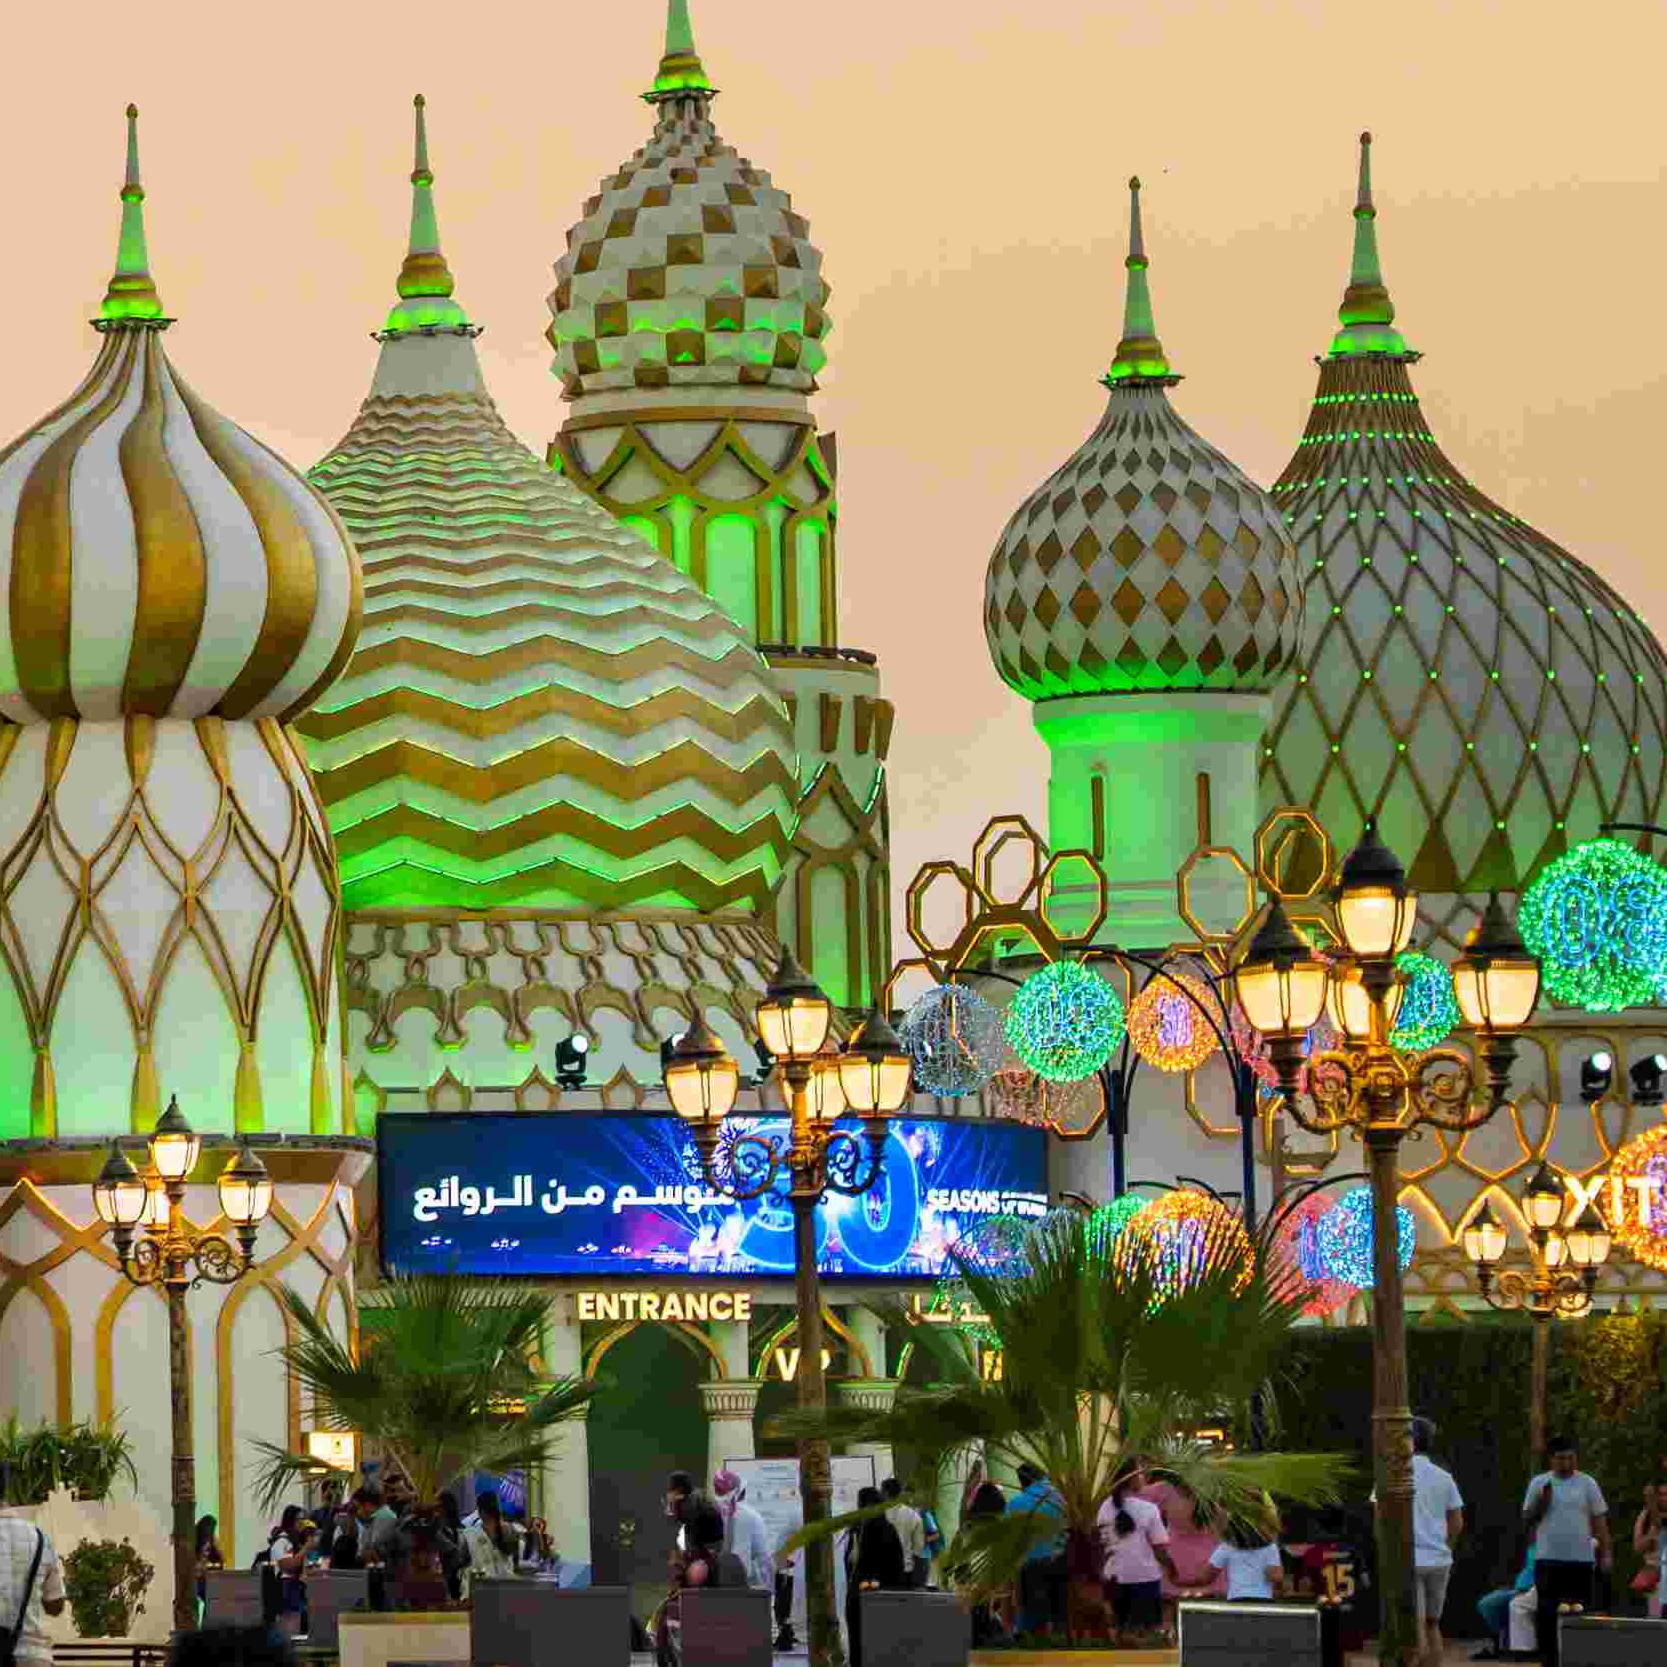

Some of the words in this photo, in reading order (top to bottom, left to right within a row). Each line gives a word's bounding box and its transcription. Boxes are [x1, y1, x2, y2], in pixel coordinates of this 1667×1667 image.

[413, 1174, 534, 1222] الروائع
[541, 1178, 606, 1214] من
[927, 1188, 1000, 1215] SEASONS
[1563, 1175, 1660, 1230] XIT
[578, 1292, 752, 1321] ENTRANCE
